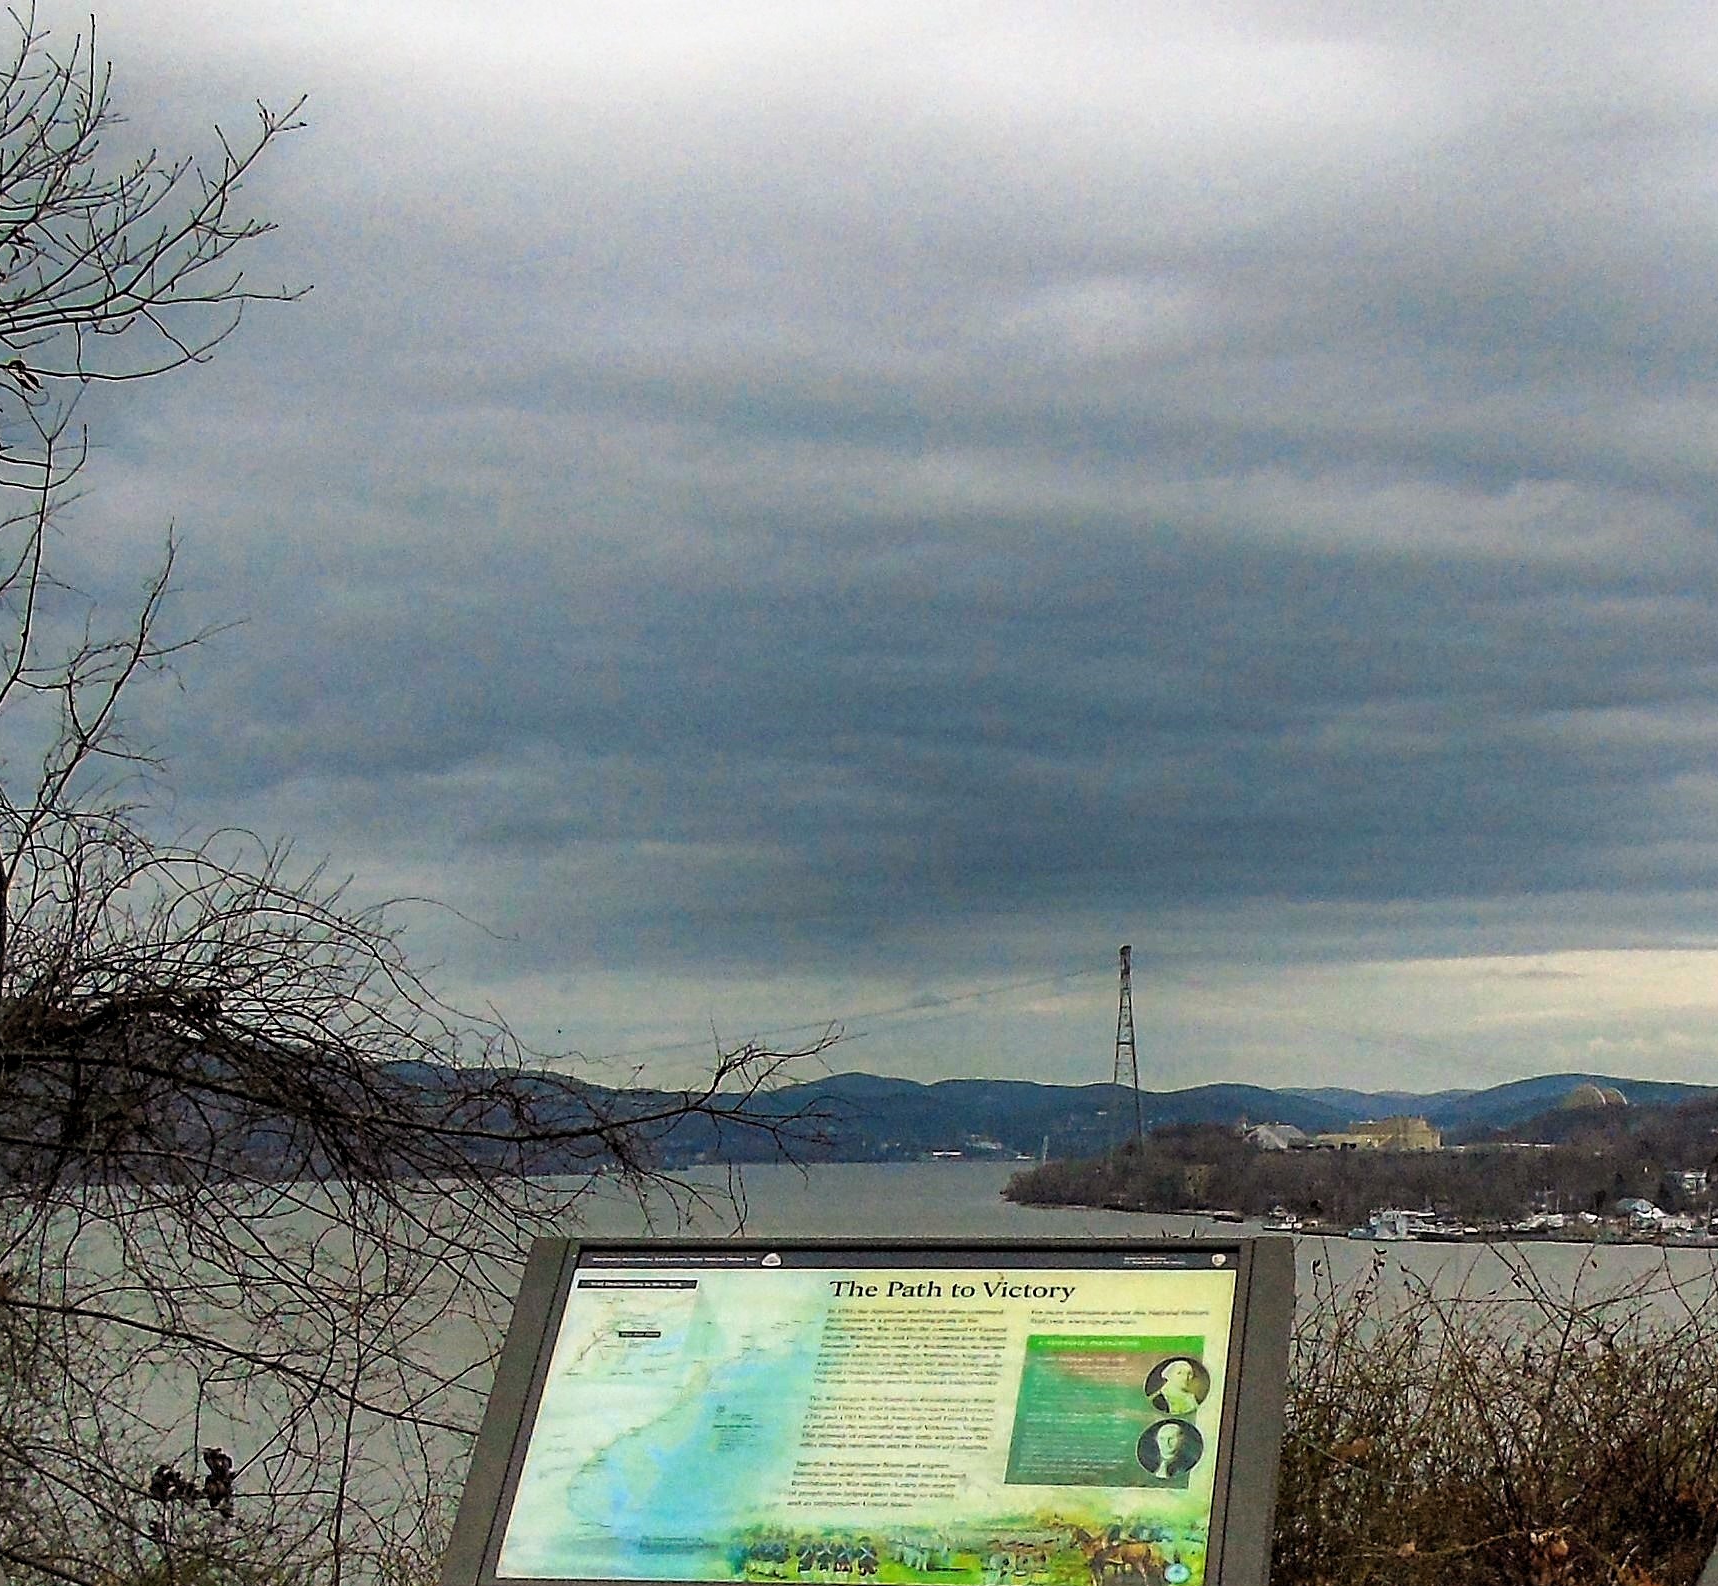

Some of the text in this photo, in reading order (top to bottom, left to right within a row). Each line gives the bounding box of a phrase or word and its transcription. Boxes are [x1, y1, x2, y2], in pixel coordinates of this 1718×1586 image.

[830, 1280, 1076, 1303] The Path to Victory
